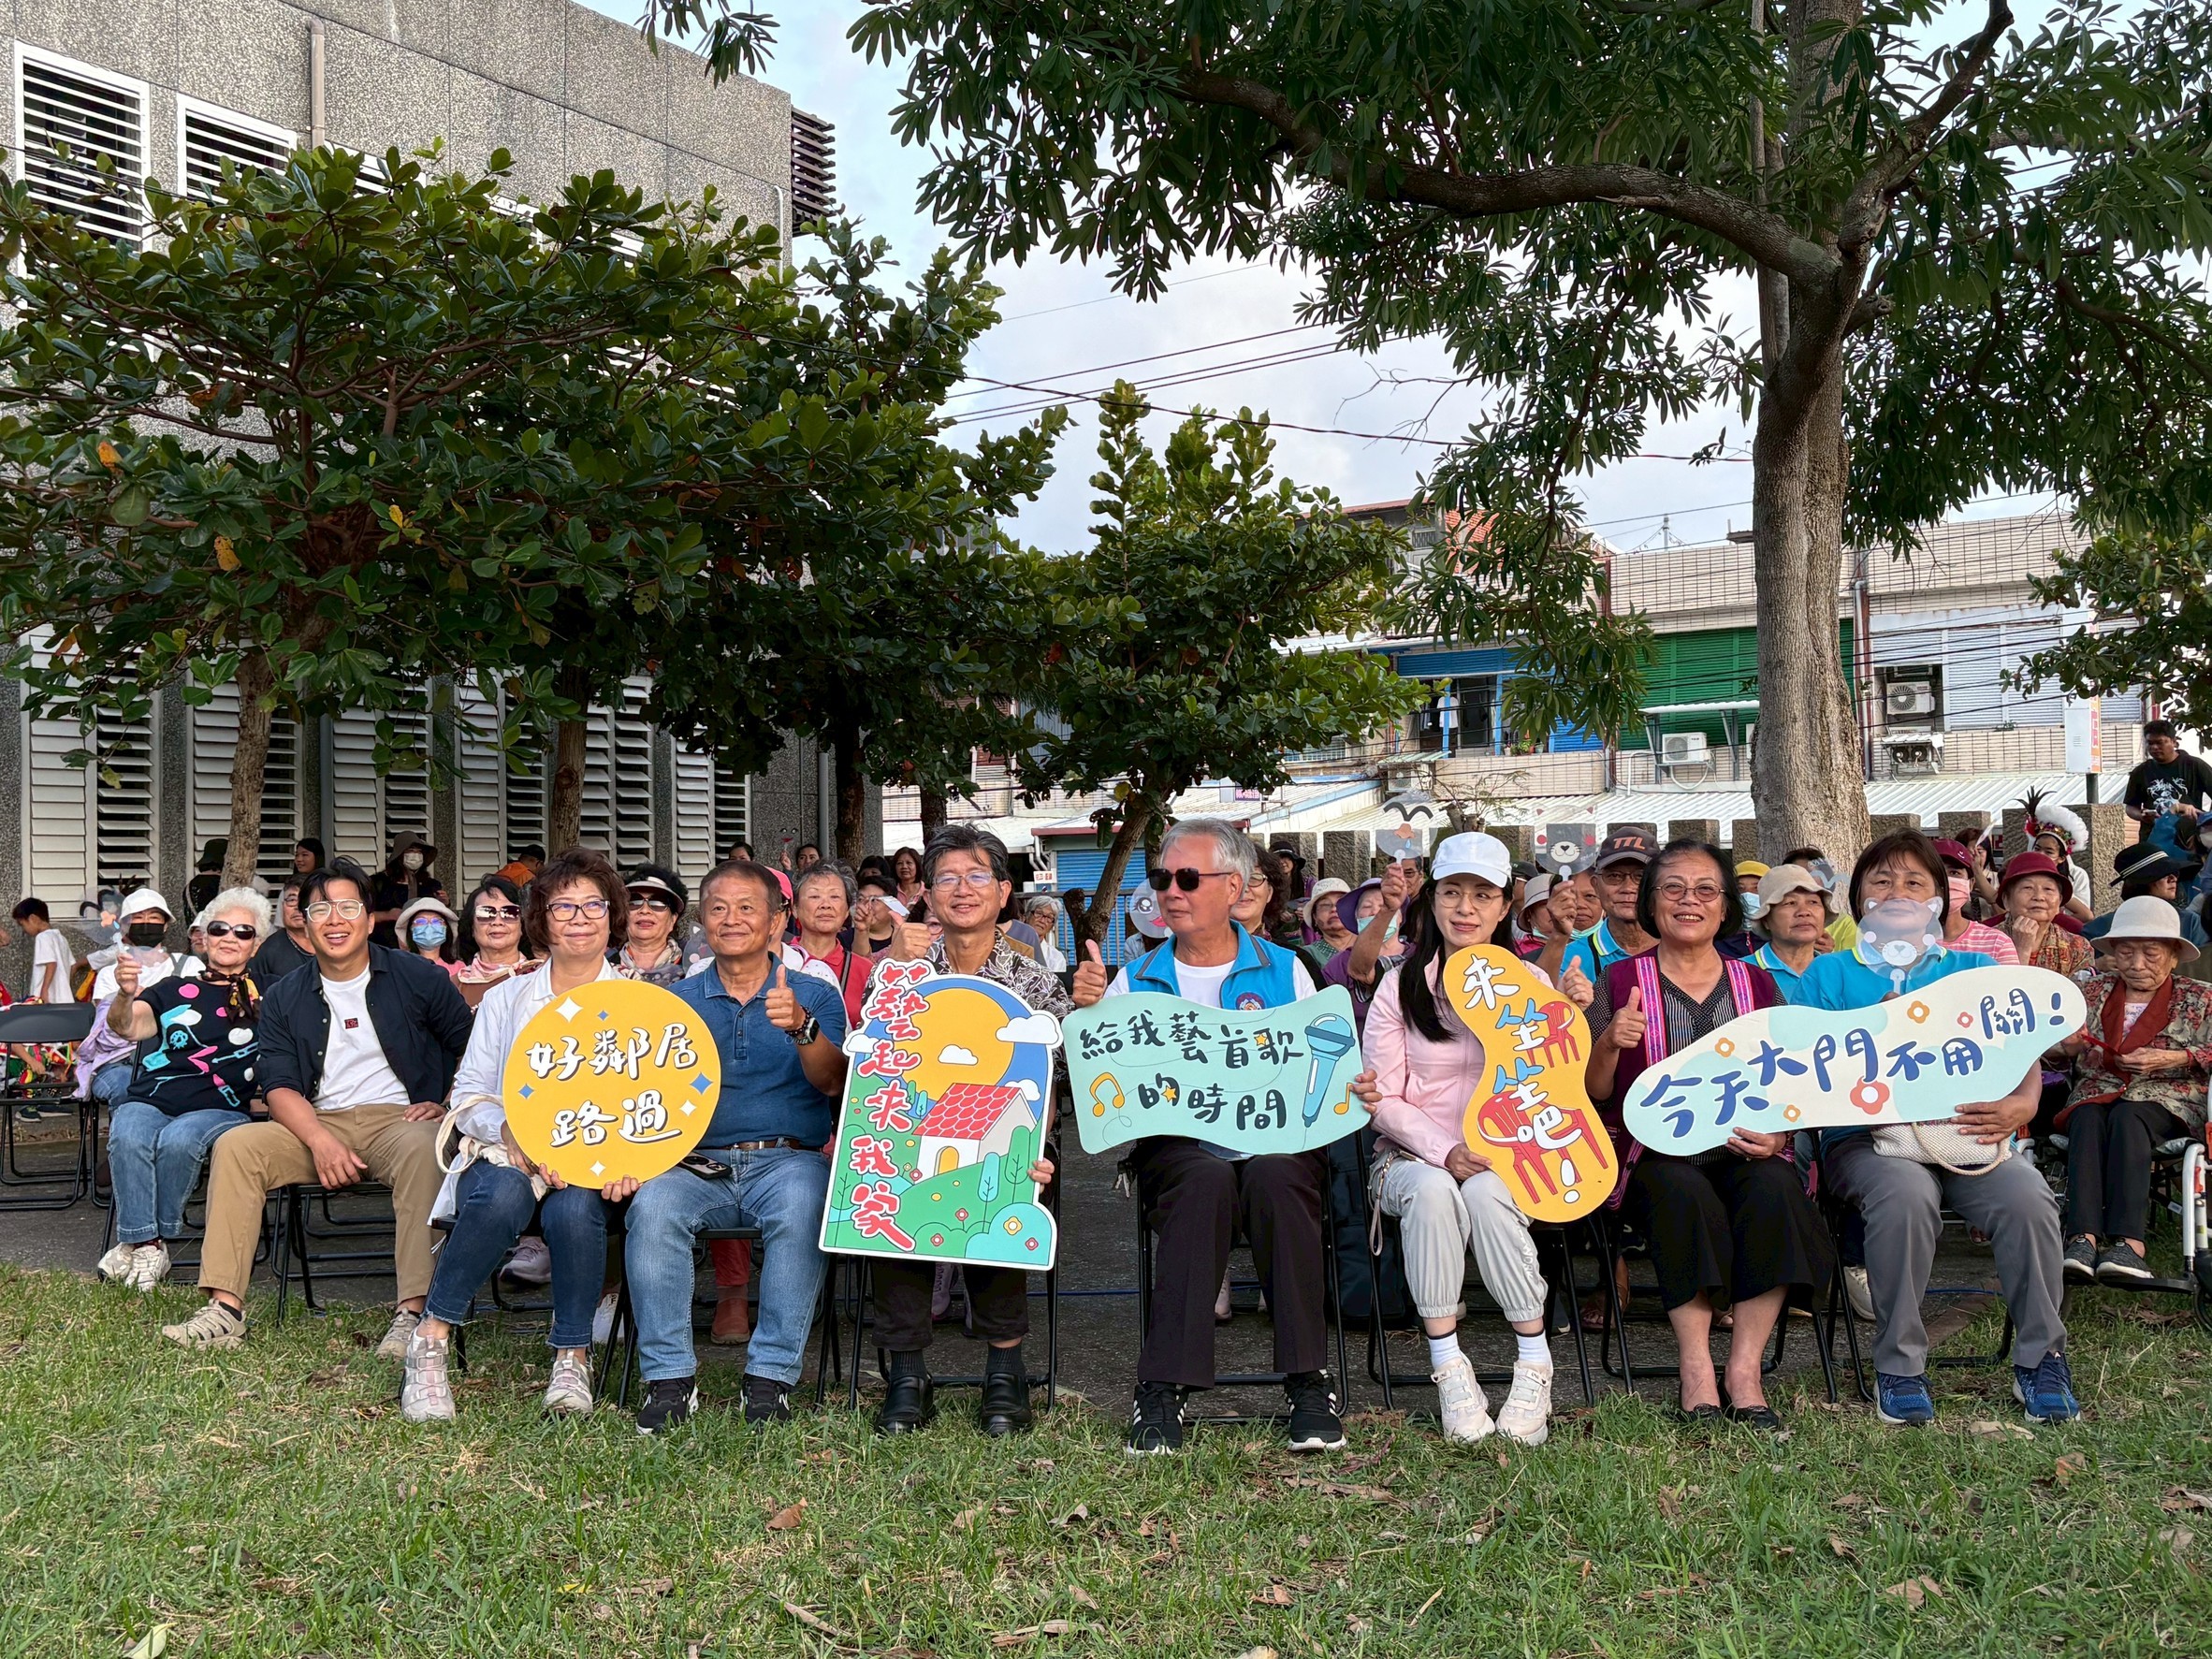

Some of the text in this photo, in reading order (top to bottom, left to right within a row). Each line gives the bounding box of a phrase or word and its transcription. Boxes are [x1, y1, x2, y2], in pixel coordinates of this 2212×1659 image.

[1613, 836, 1646, 851] TTL
[525, 1022, 698, 1081] 好鄰居
[1080, 1009, 1304, 1069] 給我藝首歌
[549, 1089, 682, 1147] 路過
[1138, 1072, 1287, 1130] 的時間
